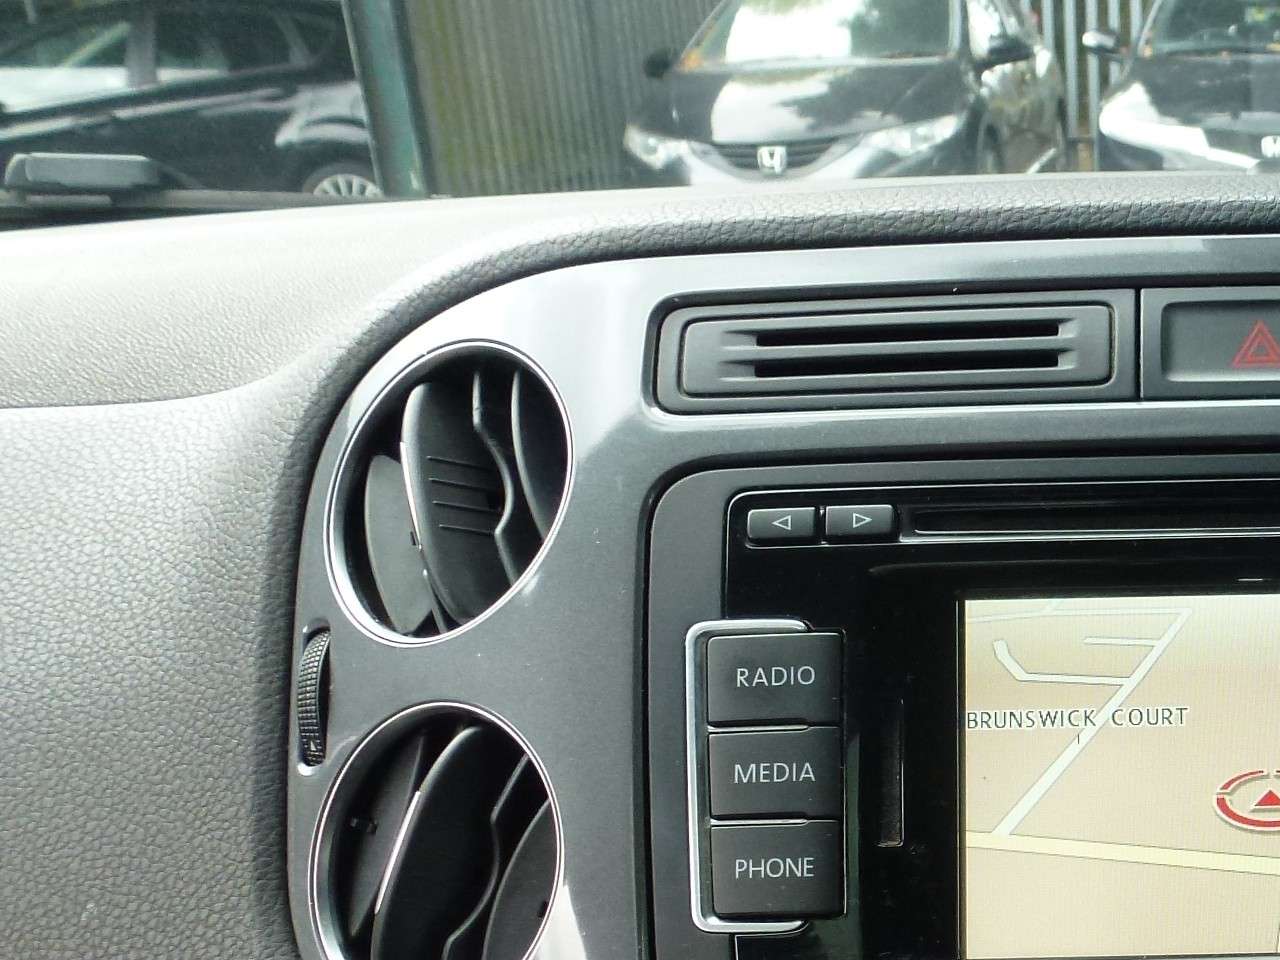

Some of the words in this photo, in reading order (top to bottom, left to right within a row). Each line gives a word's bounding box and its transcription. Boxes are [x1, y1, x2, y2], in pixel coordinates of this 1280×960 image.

[735, 665, 816, 688] RADIO
[966, 709, 1097, 729] BRUNSWICK
[1111, 705, 1189, 726] COURT
[733, 762, 816, 784] MEDIA
[735, 857, 814, 880] PHONE
